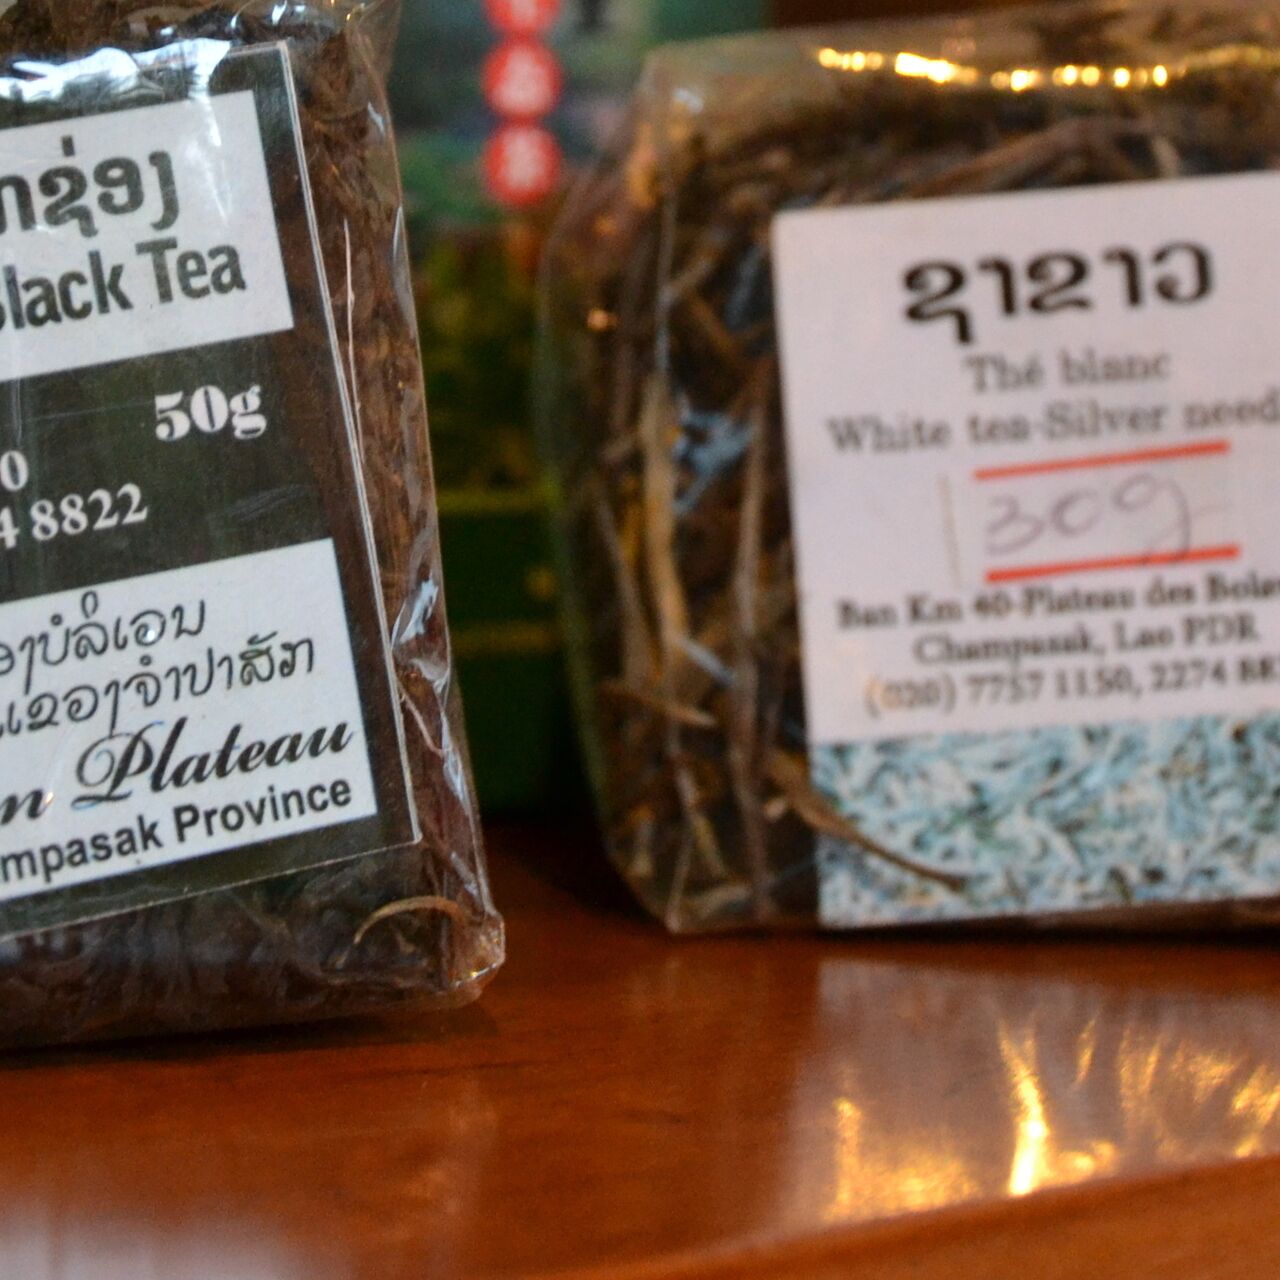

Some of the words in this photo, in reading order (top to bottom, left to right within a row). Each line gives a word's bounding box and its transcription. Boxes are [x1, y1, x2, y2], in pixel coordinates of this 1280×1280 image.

[136, 235, 248, 305] Tea
[902, 241, 1213, 344] ຊາຂາວ
[1059, 347, 1169, 387] blanc
[155, 382, 268, 442] 50g
[826, 410, 951, 454] White
[29, 482, 150, 541] 8822
[905, 592, 964, 623] Km
[1145, 574, 1196, 608] des
[1113, 619, 1175, 651] Lao
[1149, 656, 1227, 692] 2274
[70, 716, 356, 811] Plateau
[171, 774, 353, 846] Province
